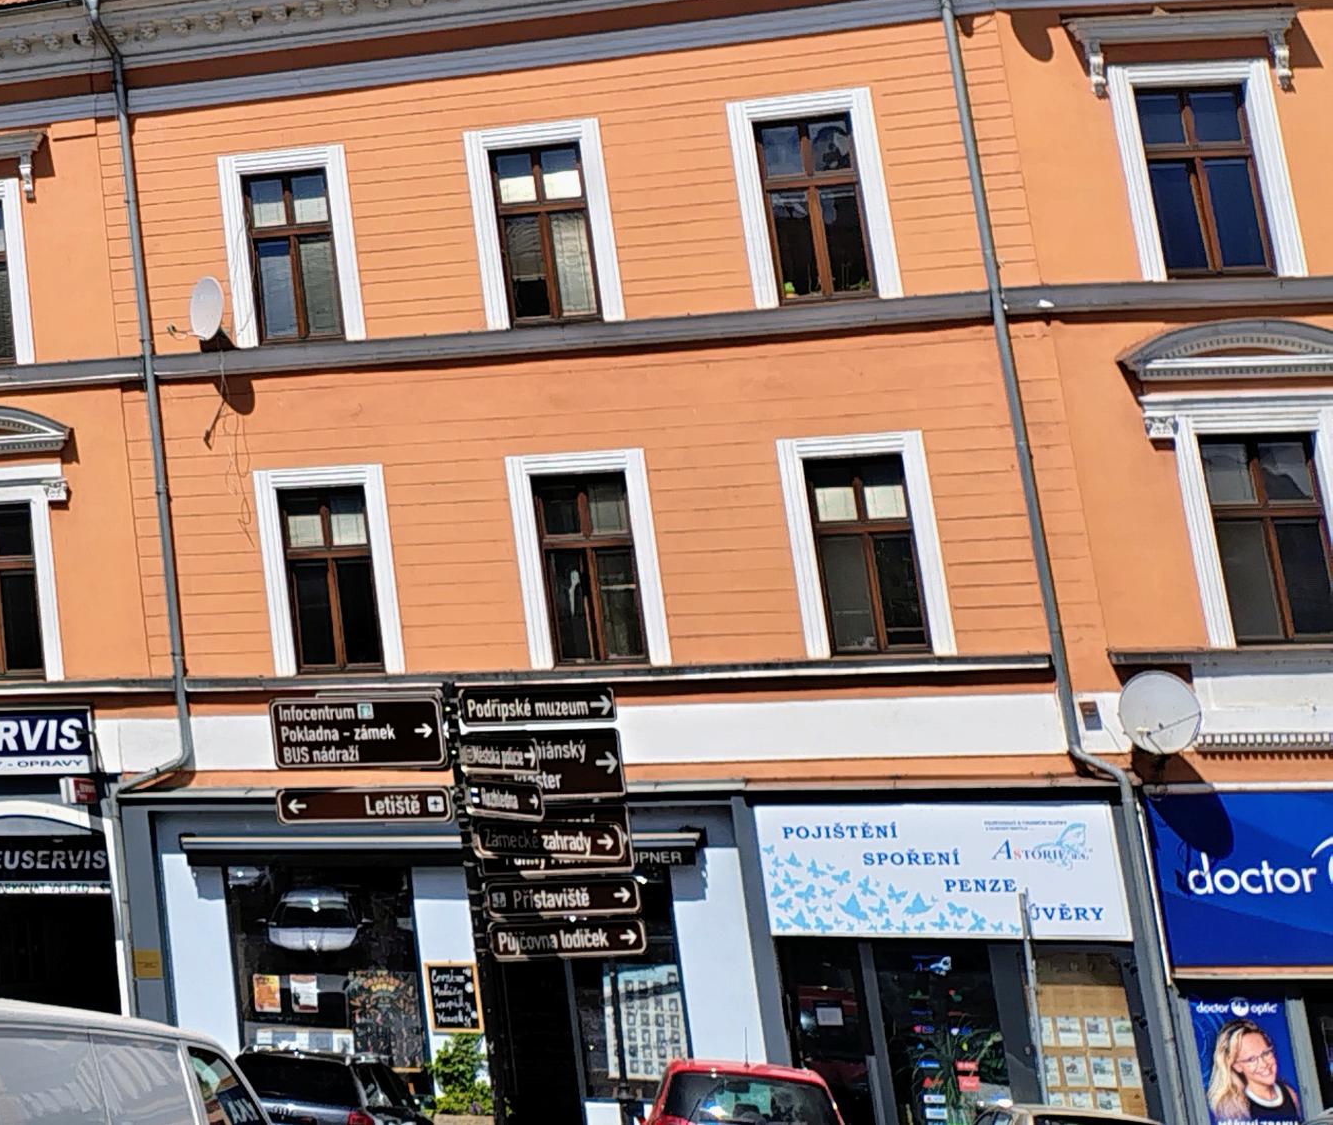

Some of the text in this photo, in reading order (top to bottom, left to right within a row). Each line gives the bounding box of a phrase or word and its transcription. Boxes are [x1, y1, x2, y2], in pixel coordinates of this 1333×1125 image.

[278, 705, 355, 722] Infocentrum
[467, 697, 589, 723] Podřipské muzeum
[281, 725, 340, 742] Pokladna
[354, 723, 396, 741] zámek
[17, 758, 84, 768] OPRAVY
[283, 744, 360, 763] BUS nádraží
[364, 795, 420, 815] Letiště
[783, 822, 898, 840] POJIŠTĚNÍ
[484, 829, 591, 857] Zámecké zahrady
[862, 848, 960, 866] SPOŘENÍ
[1188, 852, 1317, 895] doctor
[944, 879, 1017, 892] PENZE
[513, 887, 590, 909] Přístaviště
[1029, 903, 1104, 921] ÚVĚRY
[497, 928, 609, 956] Půjčovna lodiček
[1195, 1001, 1278, 1016] doctor optic
